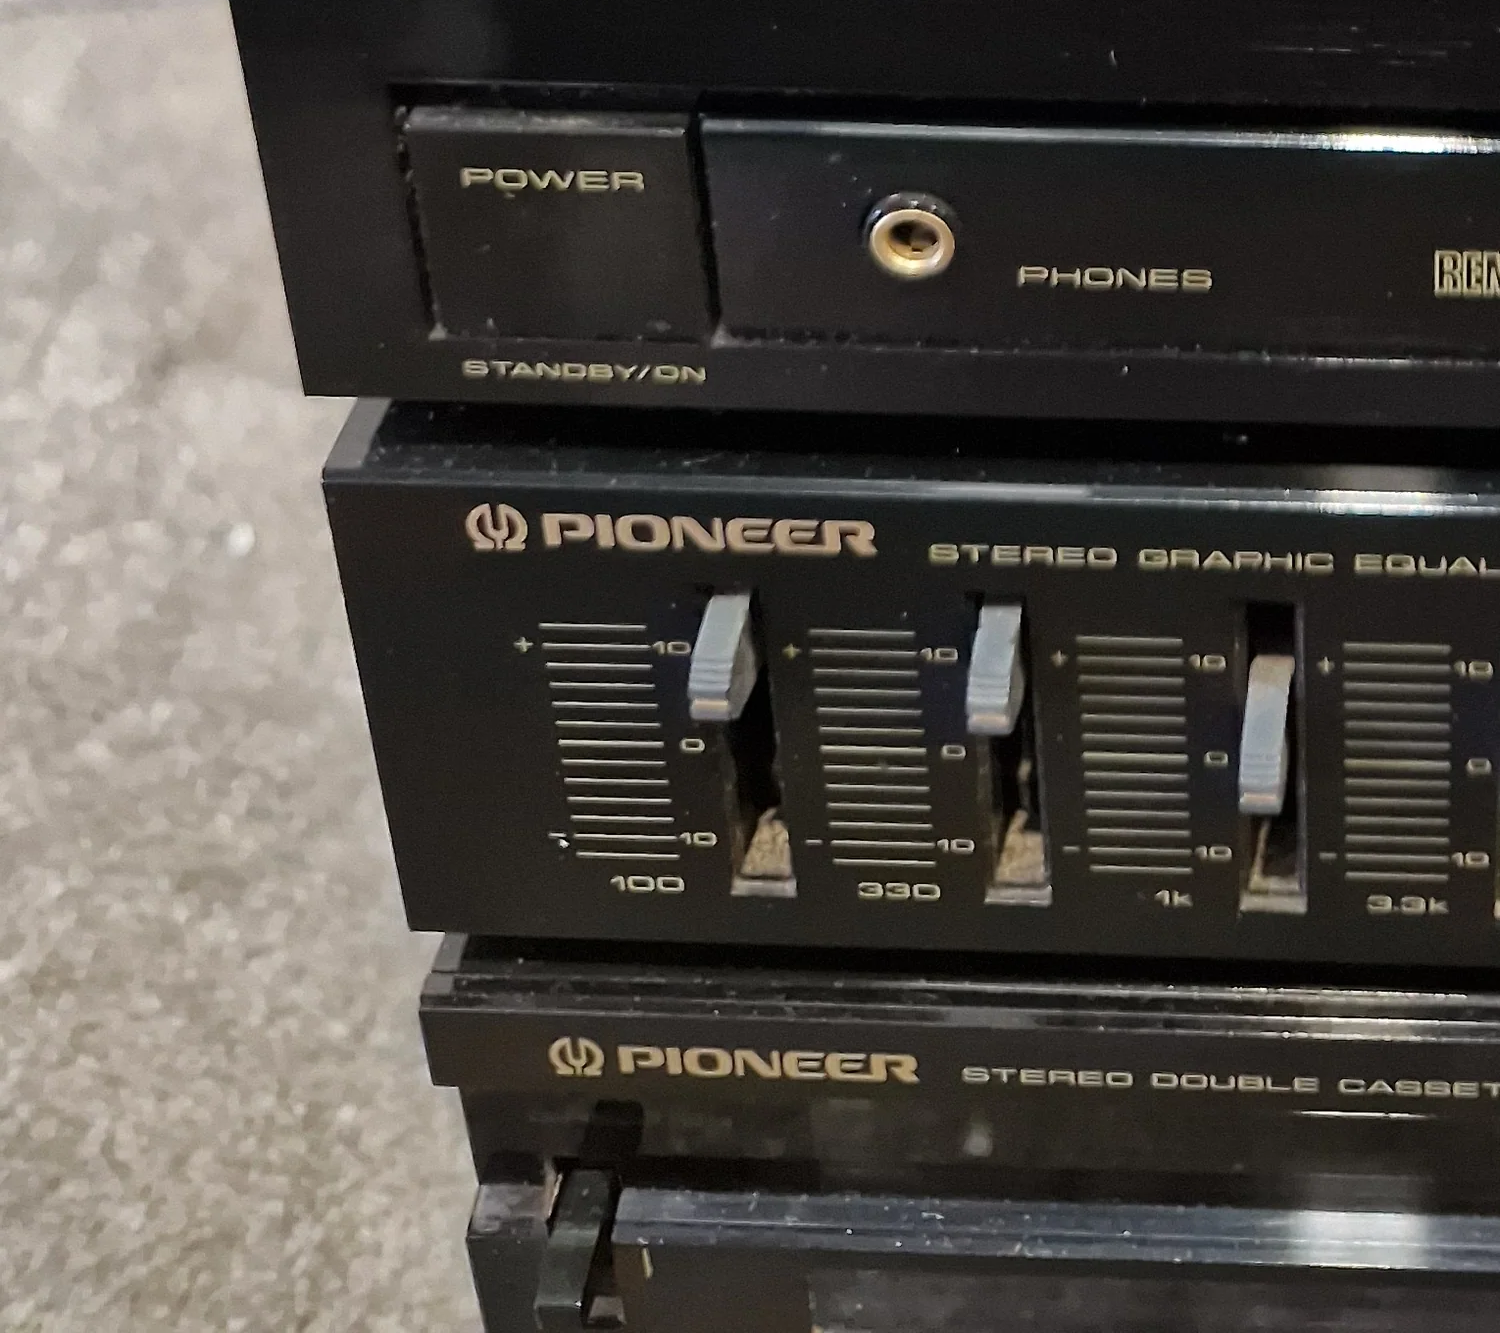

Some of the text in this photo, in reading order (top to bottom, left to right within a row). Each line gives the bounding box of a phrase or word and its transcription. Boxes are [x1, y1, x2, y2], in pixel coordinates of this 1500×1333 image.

[460, 167, 645, 192] POWER
[1017, 265, 1213, 290] PHONES
[462, 359, 706, 383] STANDBY/ON
[541, 512, 878, 557] PIONEER
[928, 543, 1118, 568] STEREO
[1138, 548, 1334, 573] GRAPHIC
[653, 639, 692, 657] 10
[919, 647, 959, 663] 10
[1189, 654, 1227, 671] 10
[1455, 660, 1494, 677] 10
[679, 831, 718, 847] 10
[937, 838, 975, 853] 10
[1196, 845, 1233, 861] 10
[1451, 851, 1490, 868] 10
[610, 875, 685, 893] 100
[857, 881, 941, 900] 330
[617, 1045, 920, 1083] PIONEER
[961, 1066, 1134, 1087] STEREO
[1150, 1072, 1319, 1093] DOUBLE
